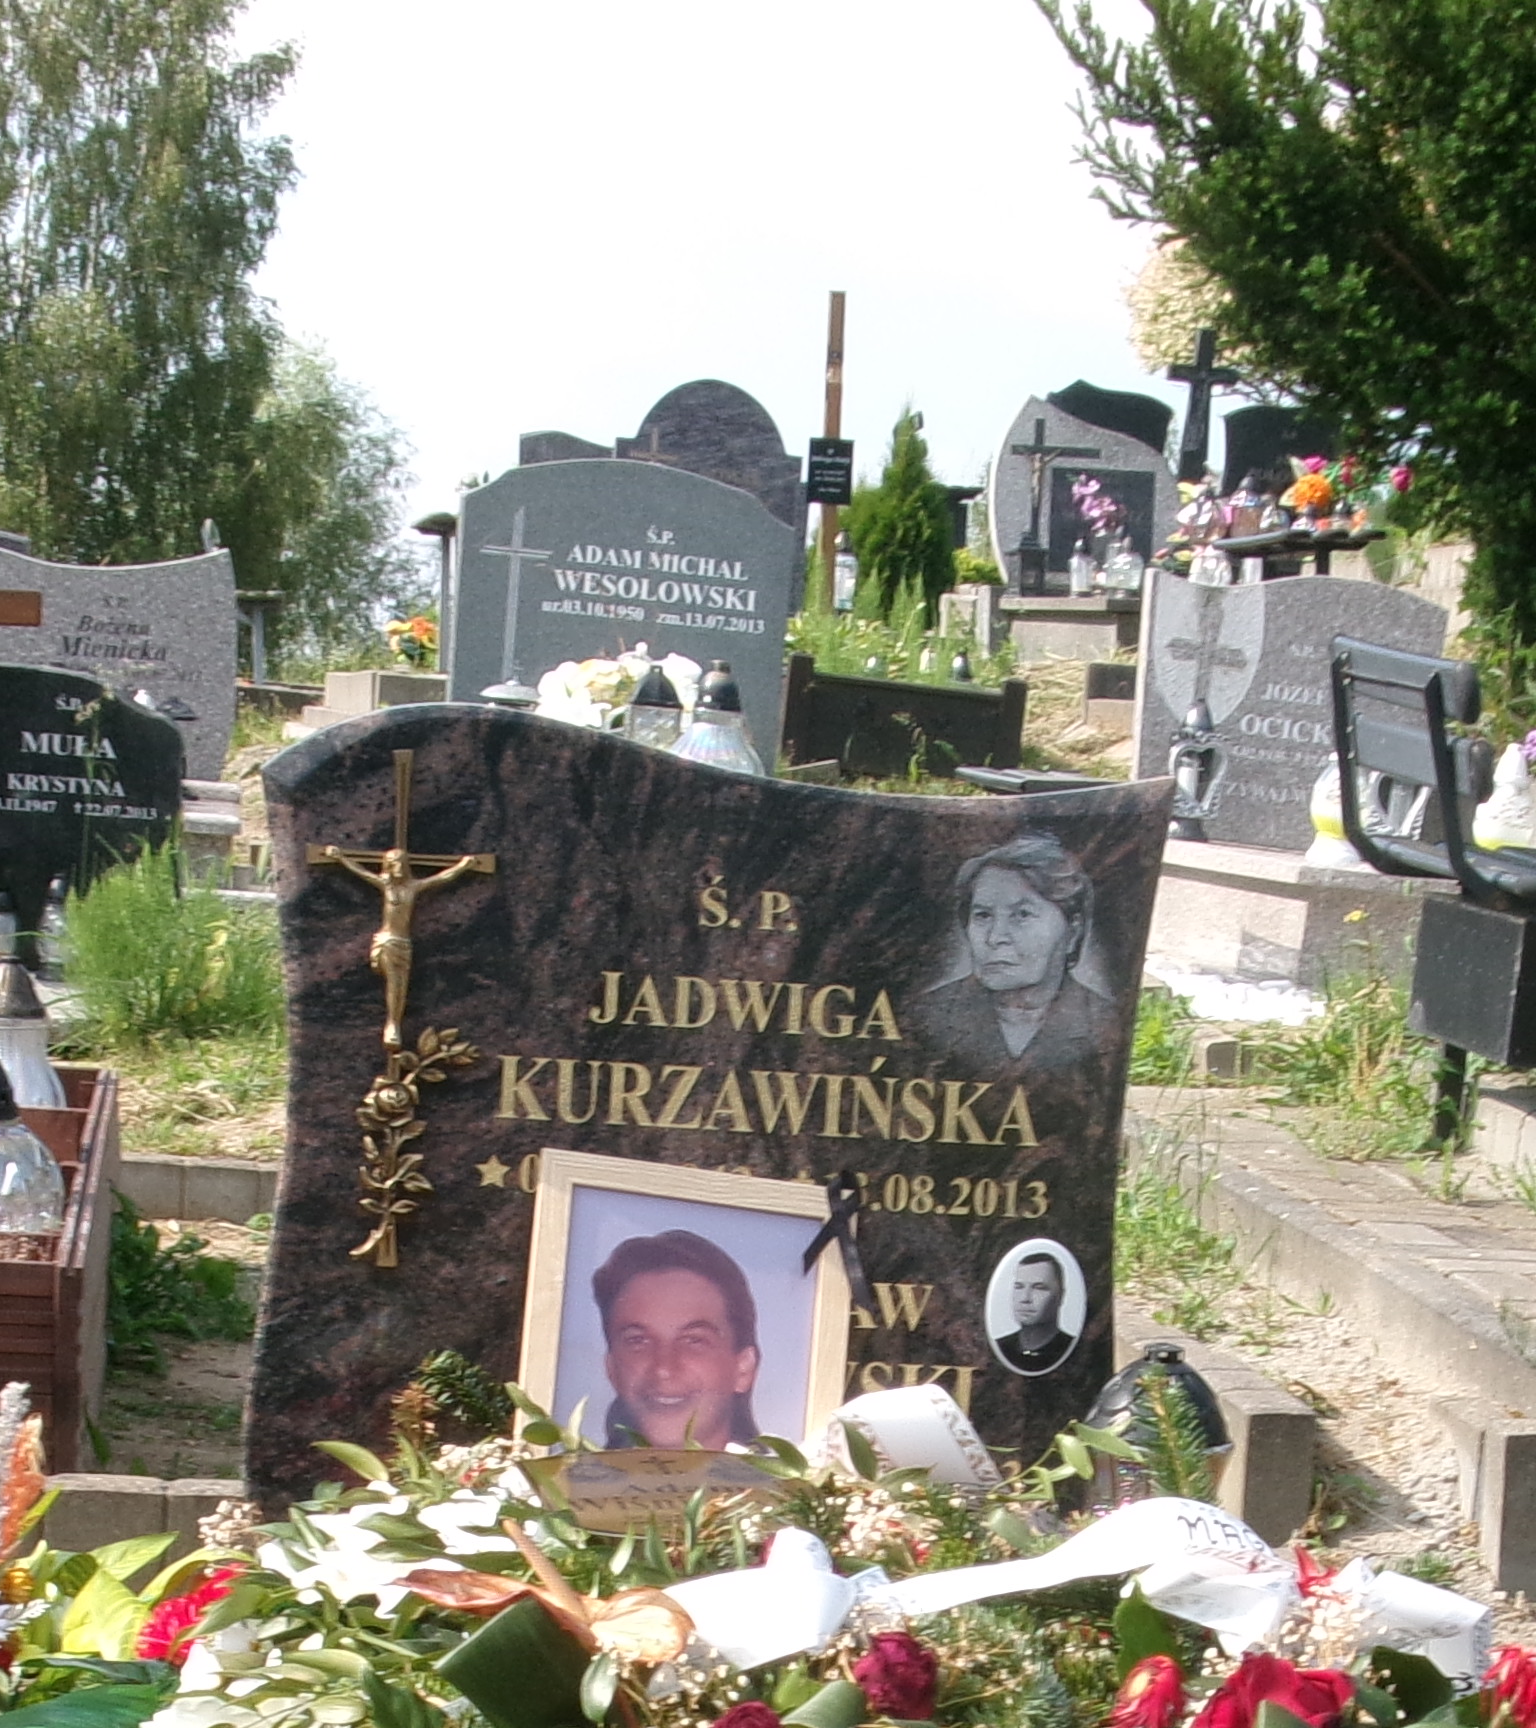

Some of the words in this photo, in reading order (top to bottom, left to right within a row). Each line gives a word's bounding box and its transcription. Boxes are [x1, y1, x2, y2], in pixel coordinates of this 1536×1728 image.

[567, 544, 643, 569] ADAM
[20, 731, 118, 760] MUŁA
[6, 772, 127, 798] KRYSTYNA
[759, 890, 799, 932] P.
[588, 970, 902, 1041] JADWIGA
[493, 1056, 1040, 1148] KURZAWIŃSKA
[824, 1172, 1049, 1219] .08.2013
